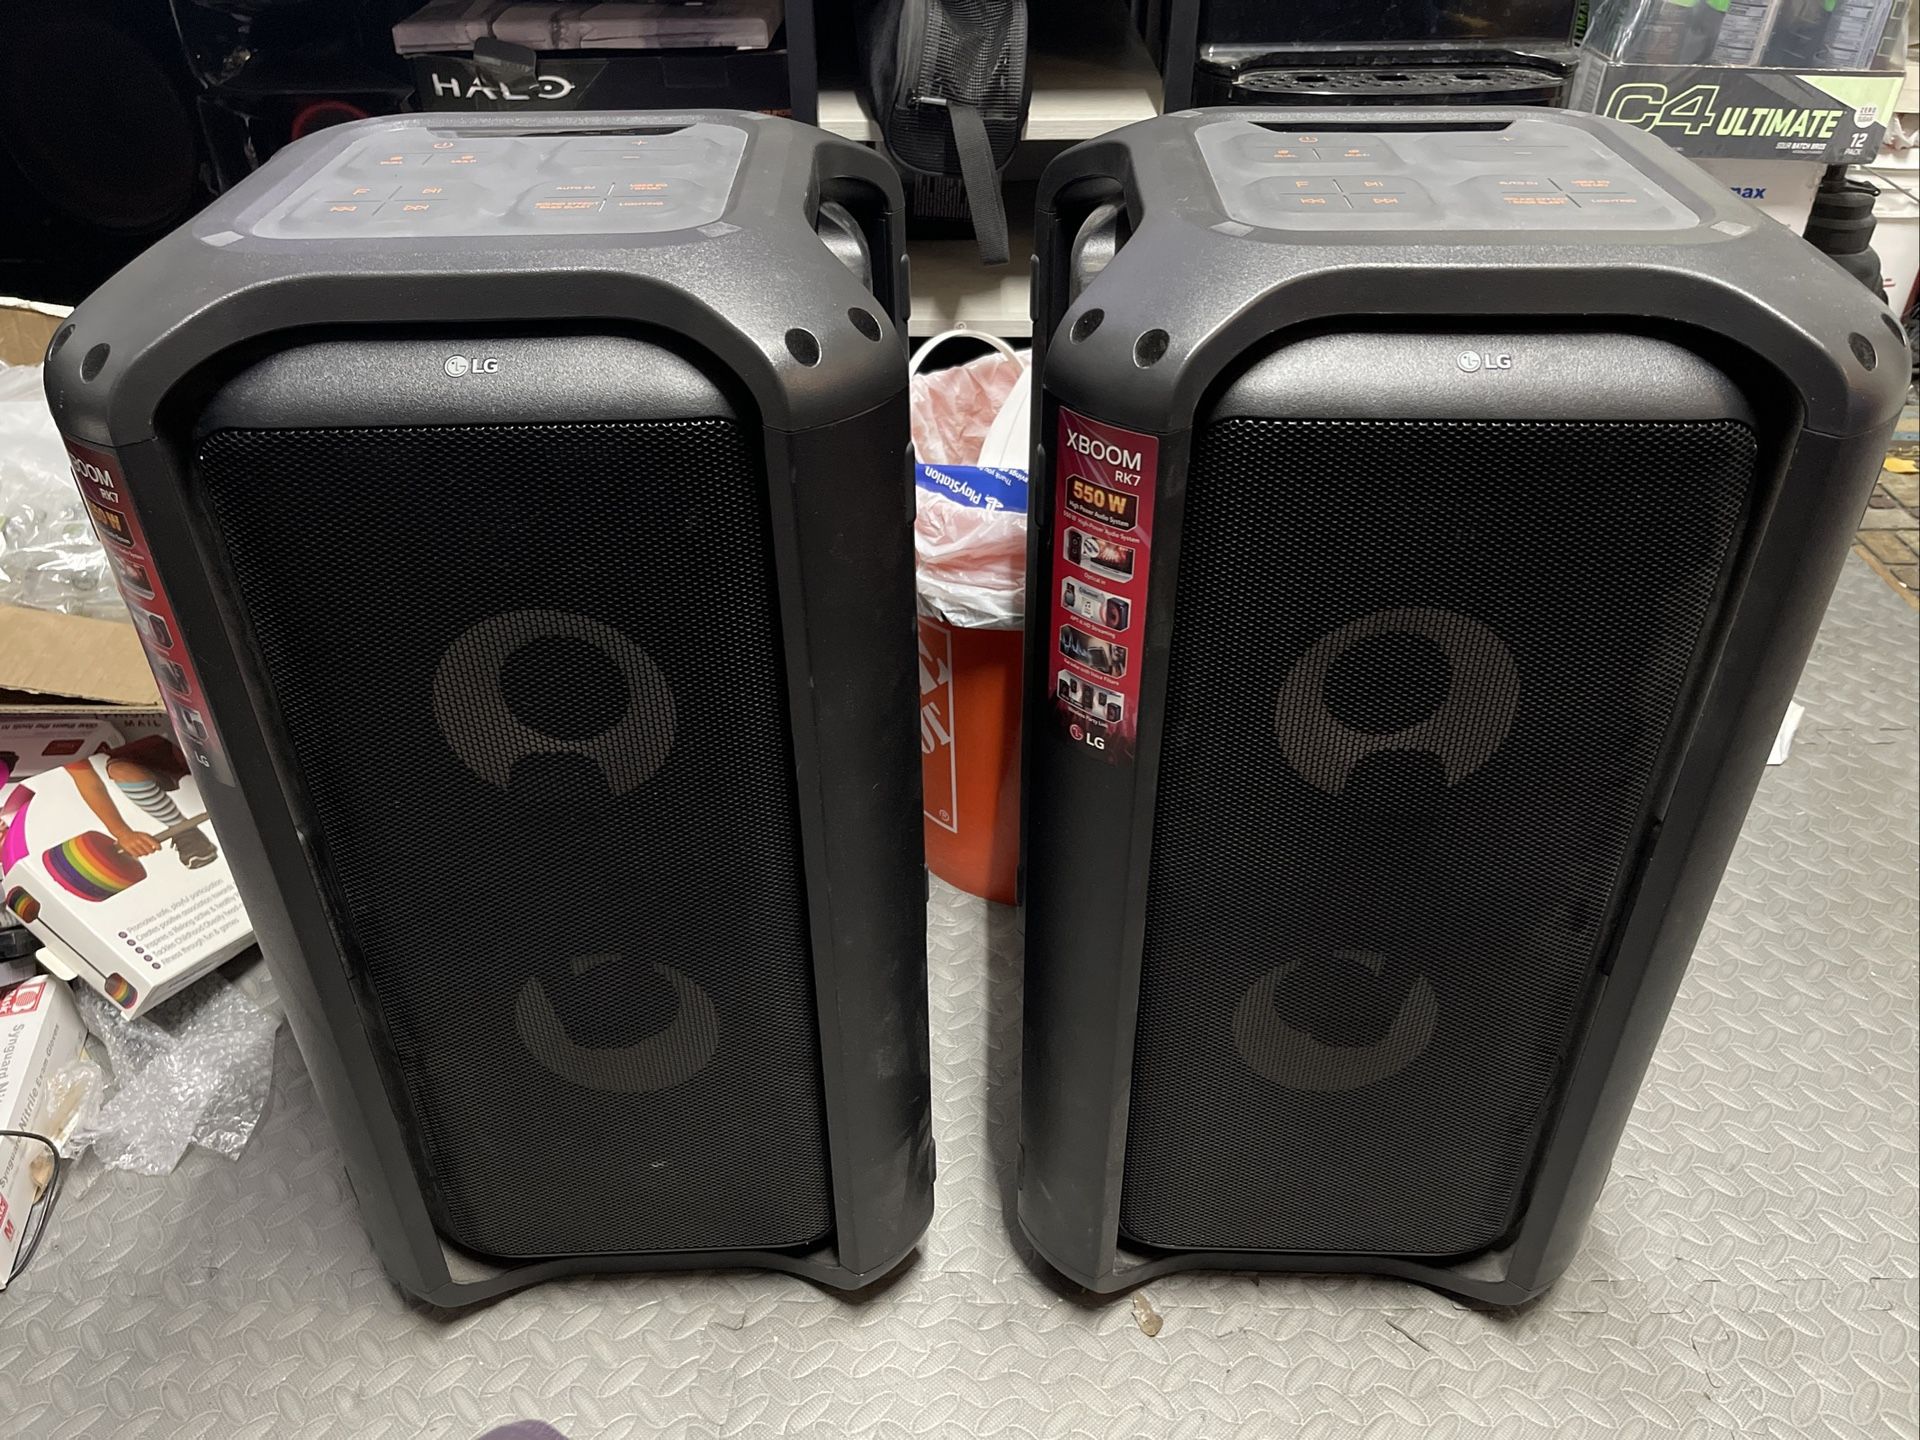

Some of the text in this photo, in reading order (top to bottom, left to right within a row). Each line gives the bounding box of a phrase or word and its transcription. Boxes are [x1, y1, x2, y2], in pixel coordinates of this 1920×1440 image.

[432, 73, 575, 100] HALO
[1604, 83, 1720, 136] C4
[1716, 107, 1843, 138] ULTIMATE
[1850, 133, 1868, 148] 12
[472, 358, 498, 374] LG
[1484, 354, 1512, 369] LG
[1066, 428, 1142, 471] XBOOM
[924, 466, 982, 504] PlayStation
[995, 472, 1012, 486] Thank
[1115, 470, 1141, 486] RK7
[1073, 480, 1126, 514] 550 W
[1079, 505, 1094, 514] Power
[1095, 512, 1109, 520] Audio
[1110, 516, 1129, 527] System
[1120, 534, 1140, 544] System
[1091, 625, 1116, 639] Streaming
[1091, 671, 1103, 679] Voice
[1104, 676, 1120, 685] Filters
[1086, 715, 1098, 724] Party
[1086, 732, 1105, 750] LG
[194, 750, 210, 767] LG
[127, 915, 156, 933] Promotes
[170, 897, 189, 910] playful
[190, 879, 223, 900] participation
[136, 926, 160, 941] Creates
[160, 914, 182, 928] positive
[182, 897, 212, 916] association
[145, 934, 168, 949] Inspires
[173, 919, 194, 934] lifelong
[194, 911, 210, 920] active
[154, 942, 176, 956] Tackles
[162, 952, 182, 964] Fitness
[182, 939, 205, 954] through
[220, 919, 239, 932] games
[18, 1088, 38, 1132] Nitrile
[46, 1024, 59, 1056] Gloves
[4, 1220, 15, 1242] M
